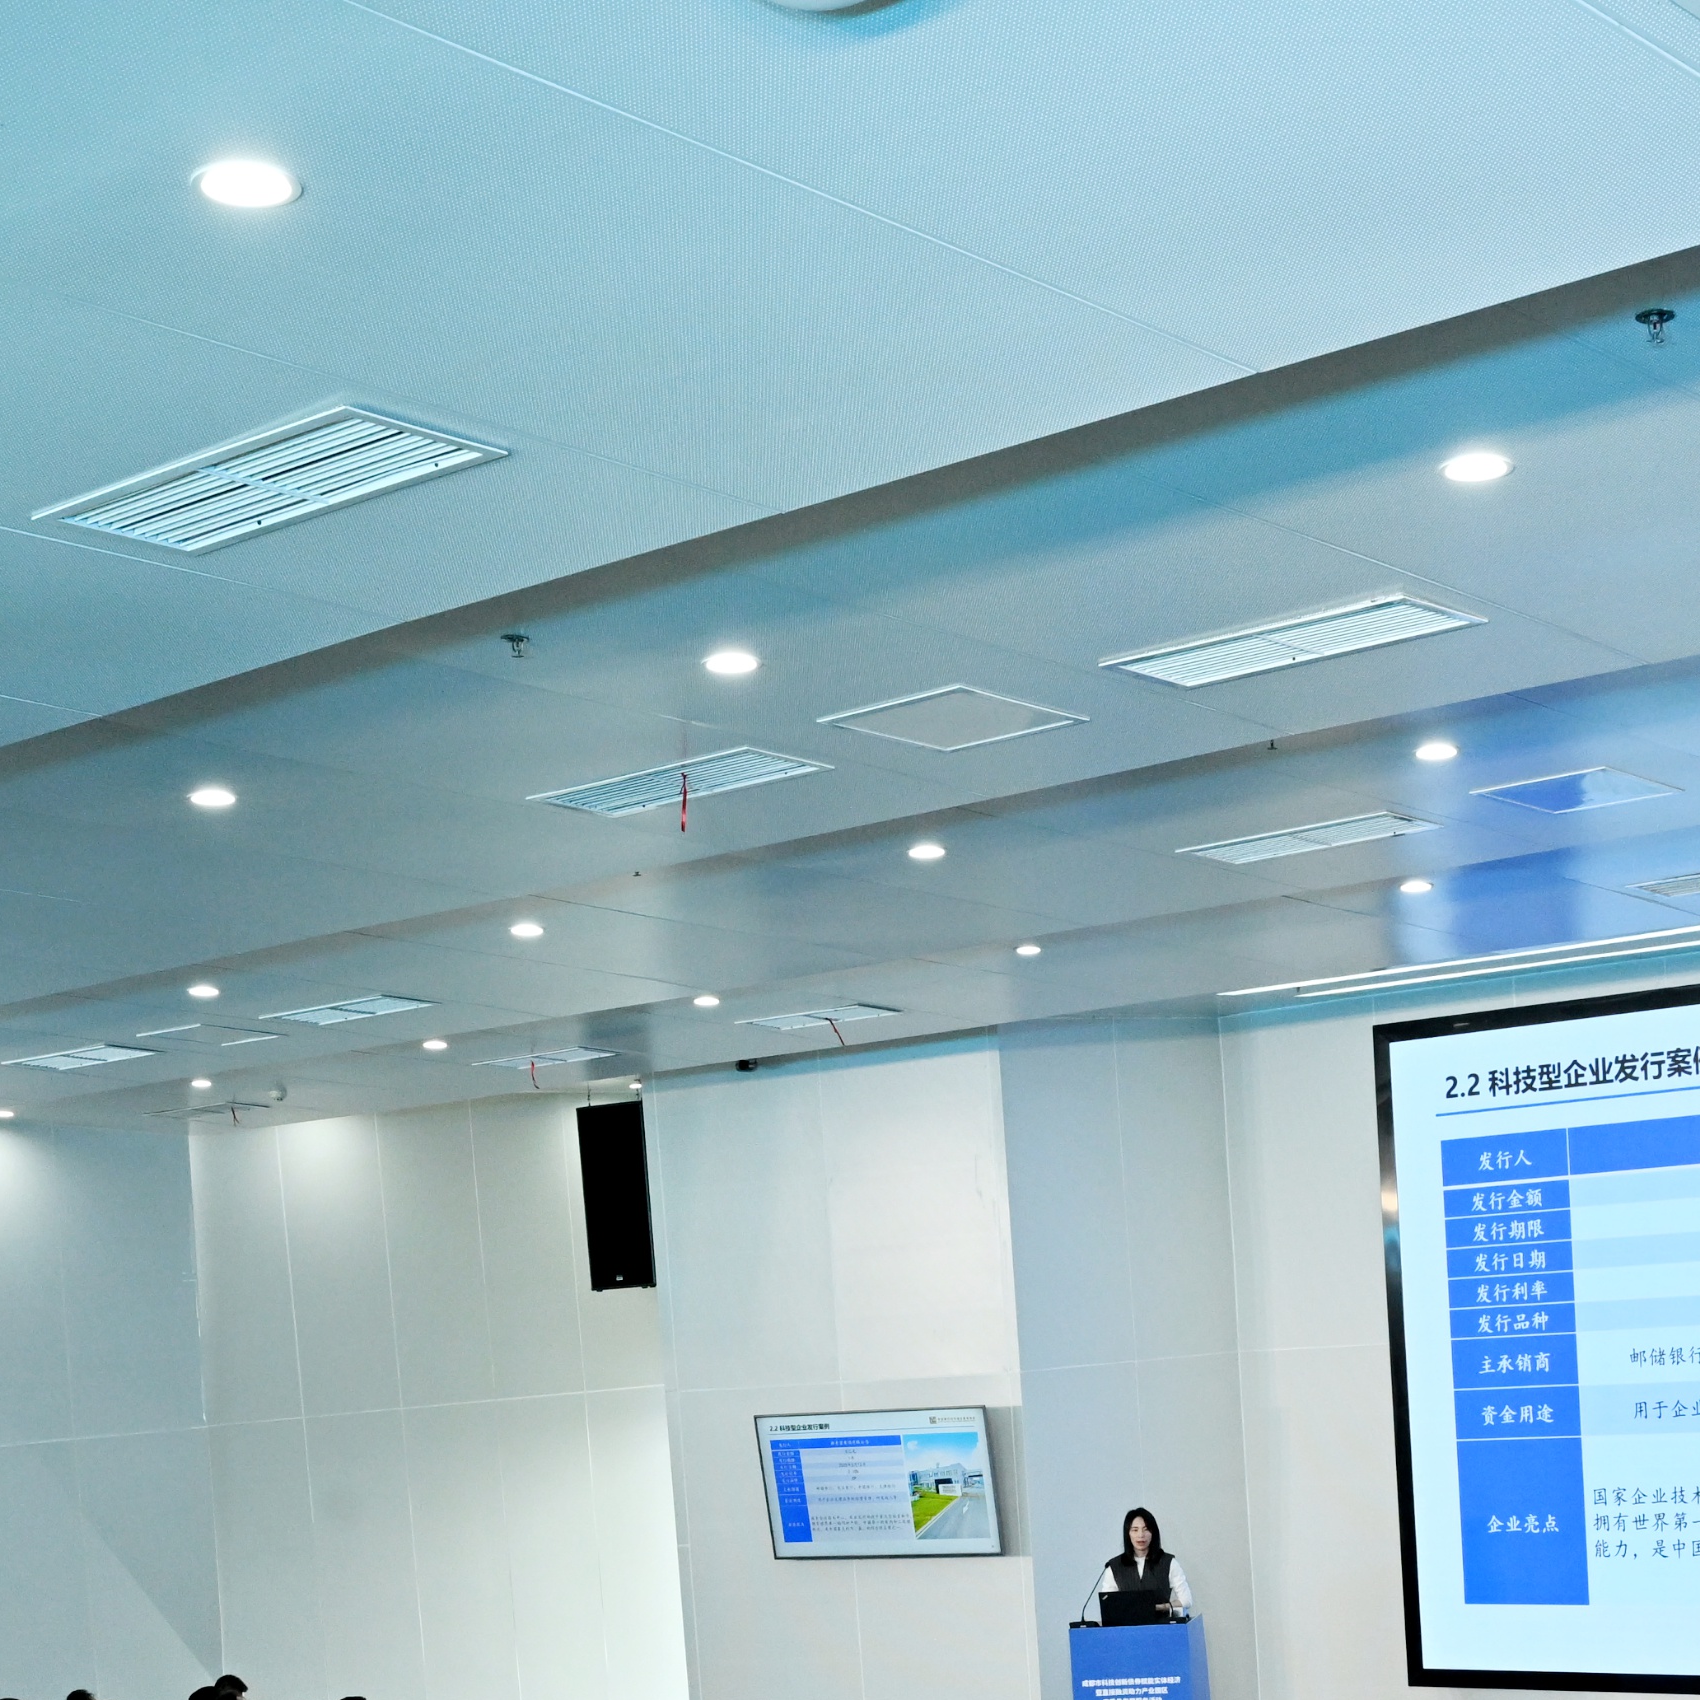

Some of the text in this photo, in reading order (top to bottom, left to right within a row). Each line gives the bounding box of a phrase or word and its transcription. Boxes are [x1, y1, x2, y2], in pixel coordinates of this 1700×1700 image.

[1445, 1073, 1481, 1099] 2.2
[1478, 1149, 1532, 1171] 发行人
[1471, 1188, 1543, 1212] 发行金额
[1472, 1218, 1545, 1242] 发行期限
[1474, 1249, 1546, 1273] 发行日期
[1476, 1279, 1548, 1304] 发行利率
[1477, 1310, 1549, 1334] 发行品种
[1478, 1351, 1551, 1374] 主承销商
[1481, 1403, 1555, 1426] 资金用途
[1487, 1513, 1560, 1534] 企业亮点
